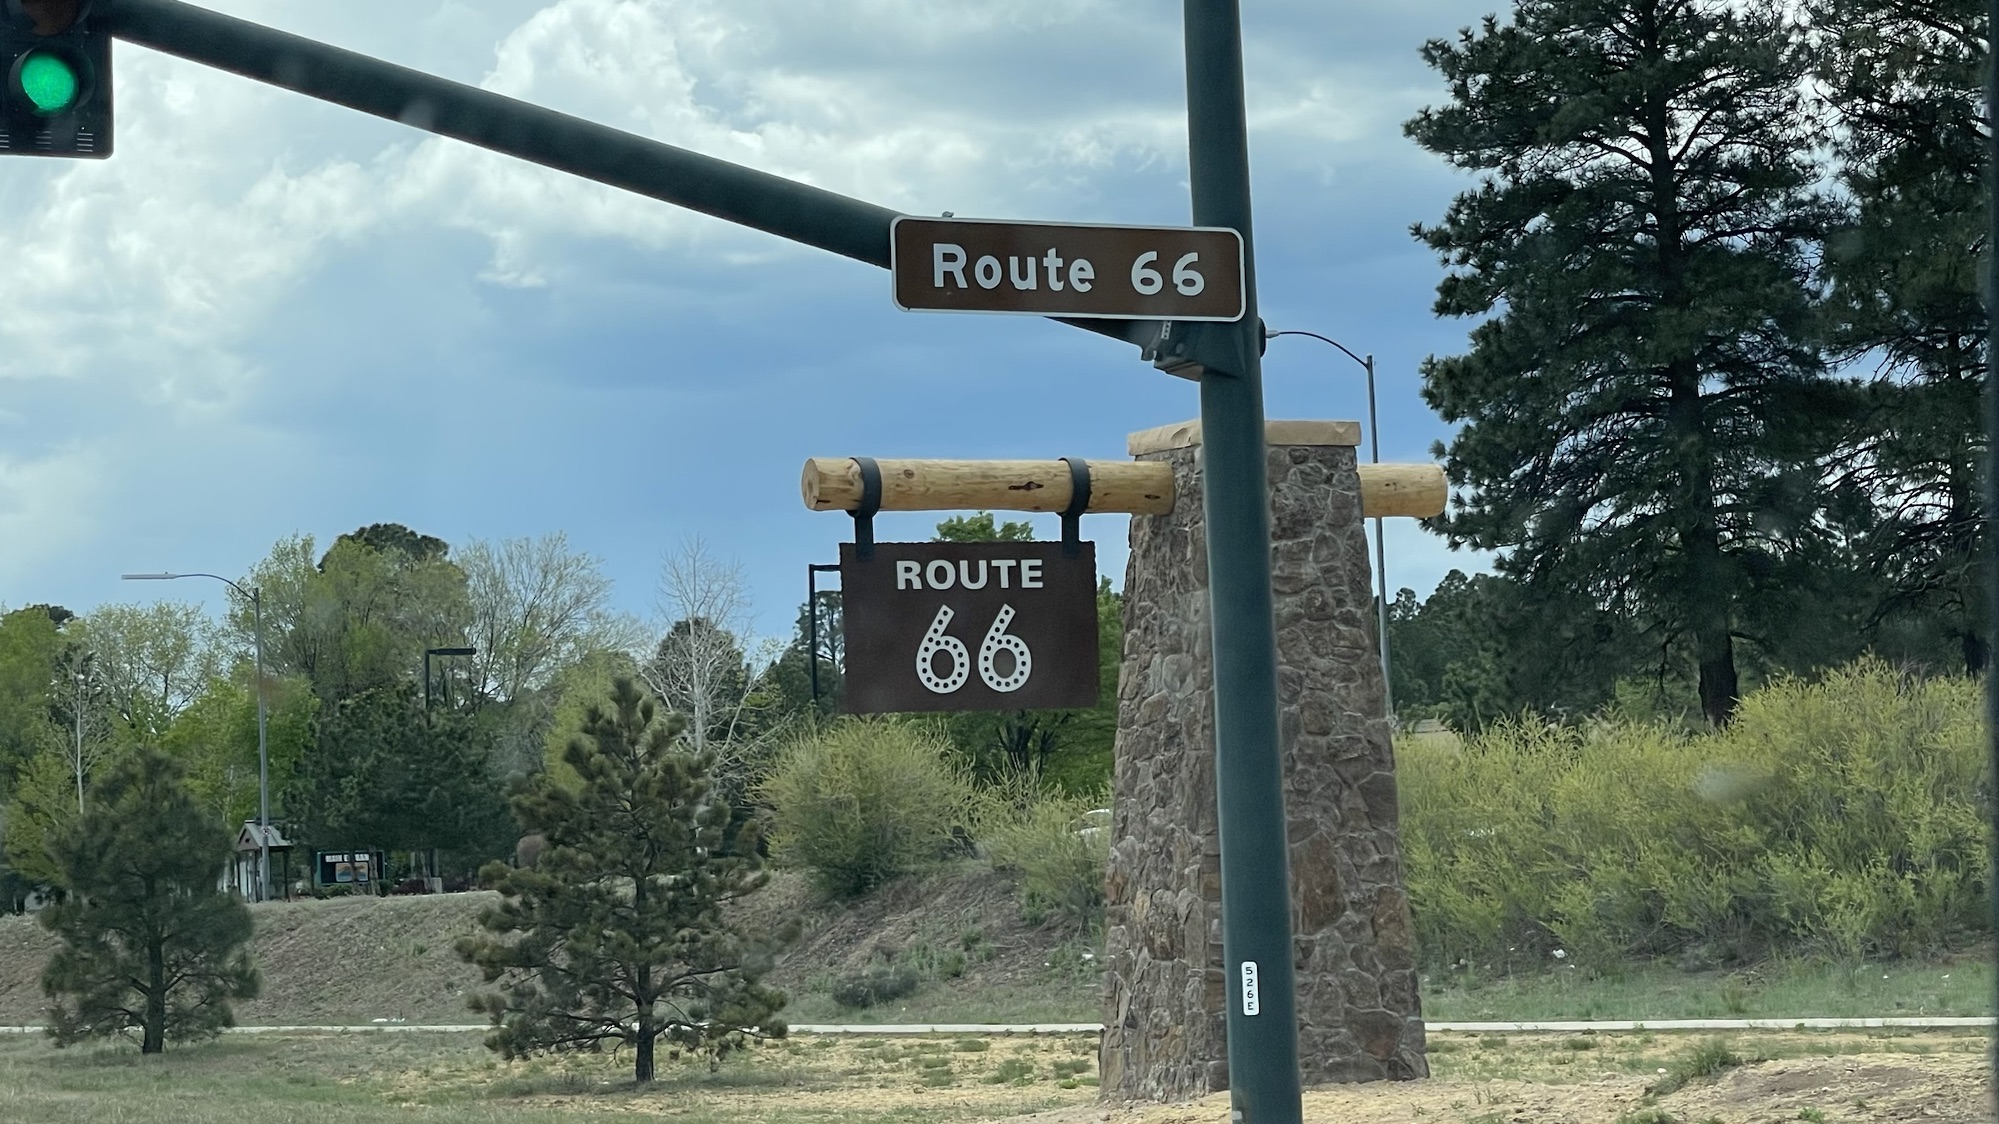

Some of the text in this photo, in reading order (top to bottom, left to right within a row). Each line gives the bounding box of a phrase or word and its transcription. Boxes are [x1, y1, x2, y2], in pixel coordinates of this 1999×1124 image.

[932, 243, 1205, 296] Route 66
[896, 559, 1043, 590] ROUTE
[916, 603, 1032, 694] 66
